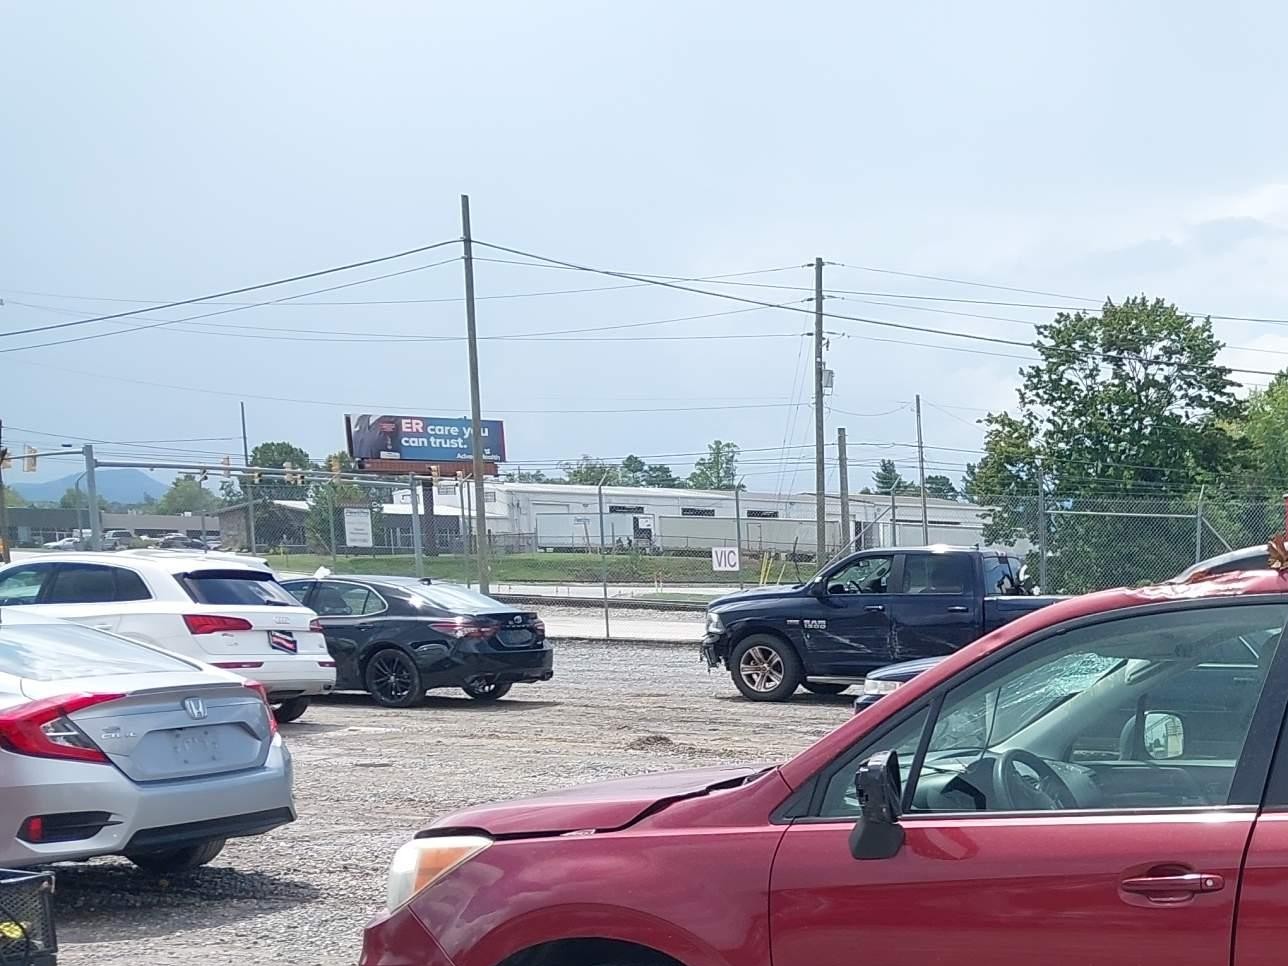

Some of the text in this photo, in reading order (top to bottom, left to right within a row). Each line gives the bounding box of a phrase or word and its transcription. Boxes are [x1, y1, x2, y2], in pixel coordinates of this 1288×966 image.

[401, 419, 424, 433] ER
[426, 425, 459, 435] care
[463, 427, 489, 438] yu
[401, 437, 468, 448] can trust.
[714, 550, 737, 568] VIC
